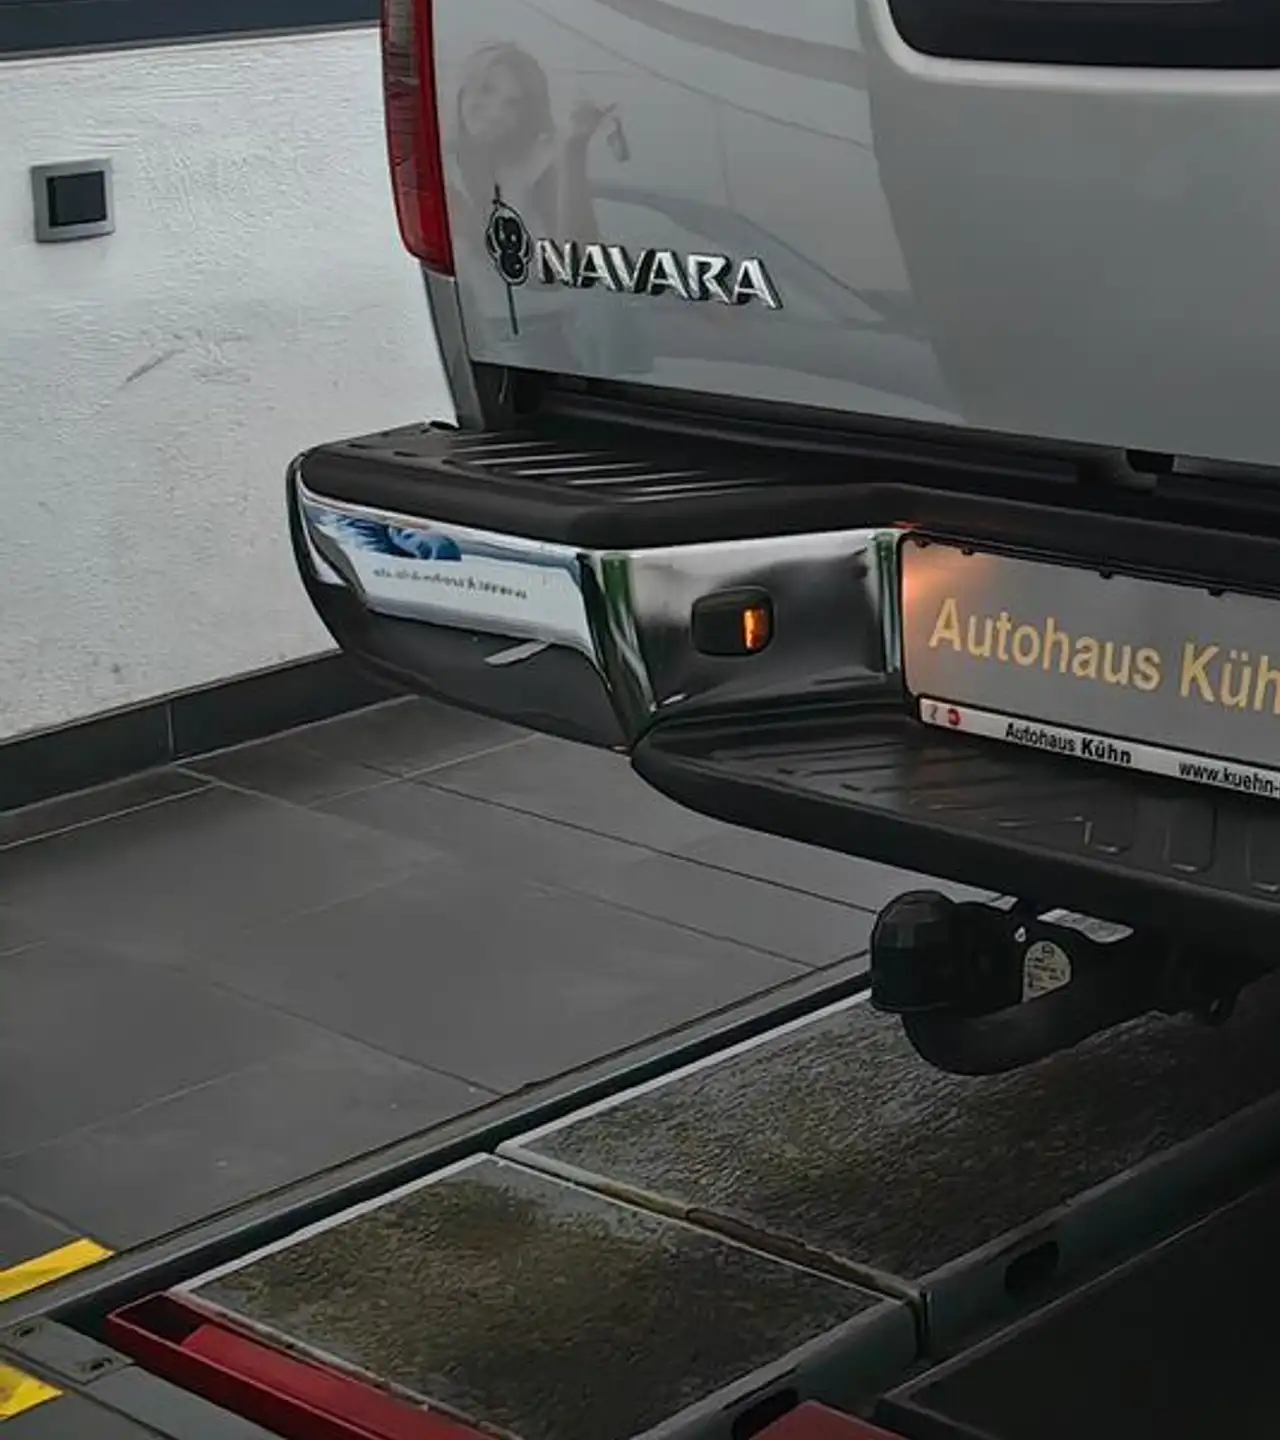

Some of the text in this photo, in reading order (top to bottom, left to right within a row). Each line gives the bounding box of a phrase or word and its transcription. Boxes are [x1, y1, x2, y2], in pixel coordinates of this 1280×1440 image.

[534, 238, 783, 309] NAVARA
[928, 597, 1162, 692] Autohaus
[1004, 722, 1133, 765] Autohaus Kühn
